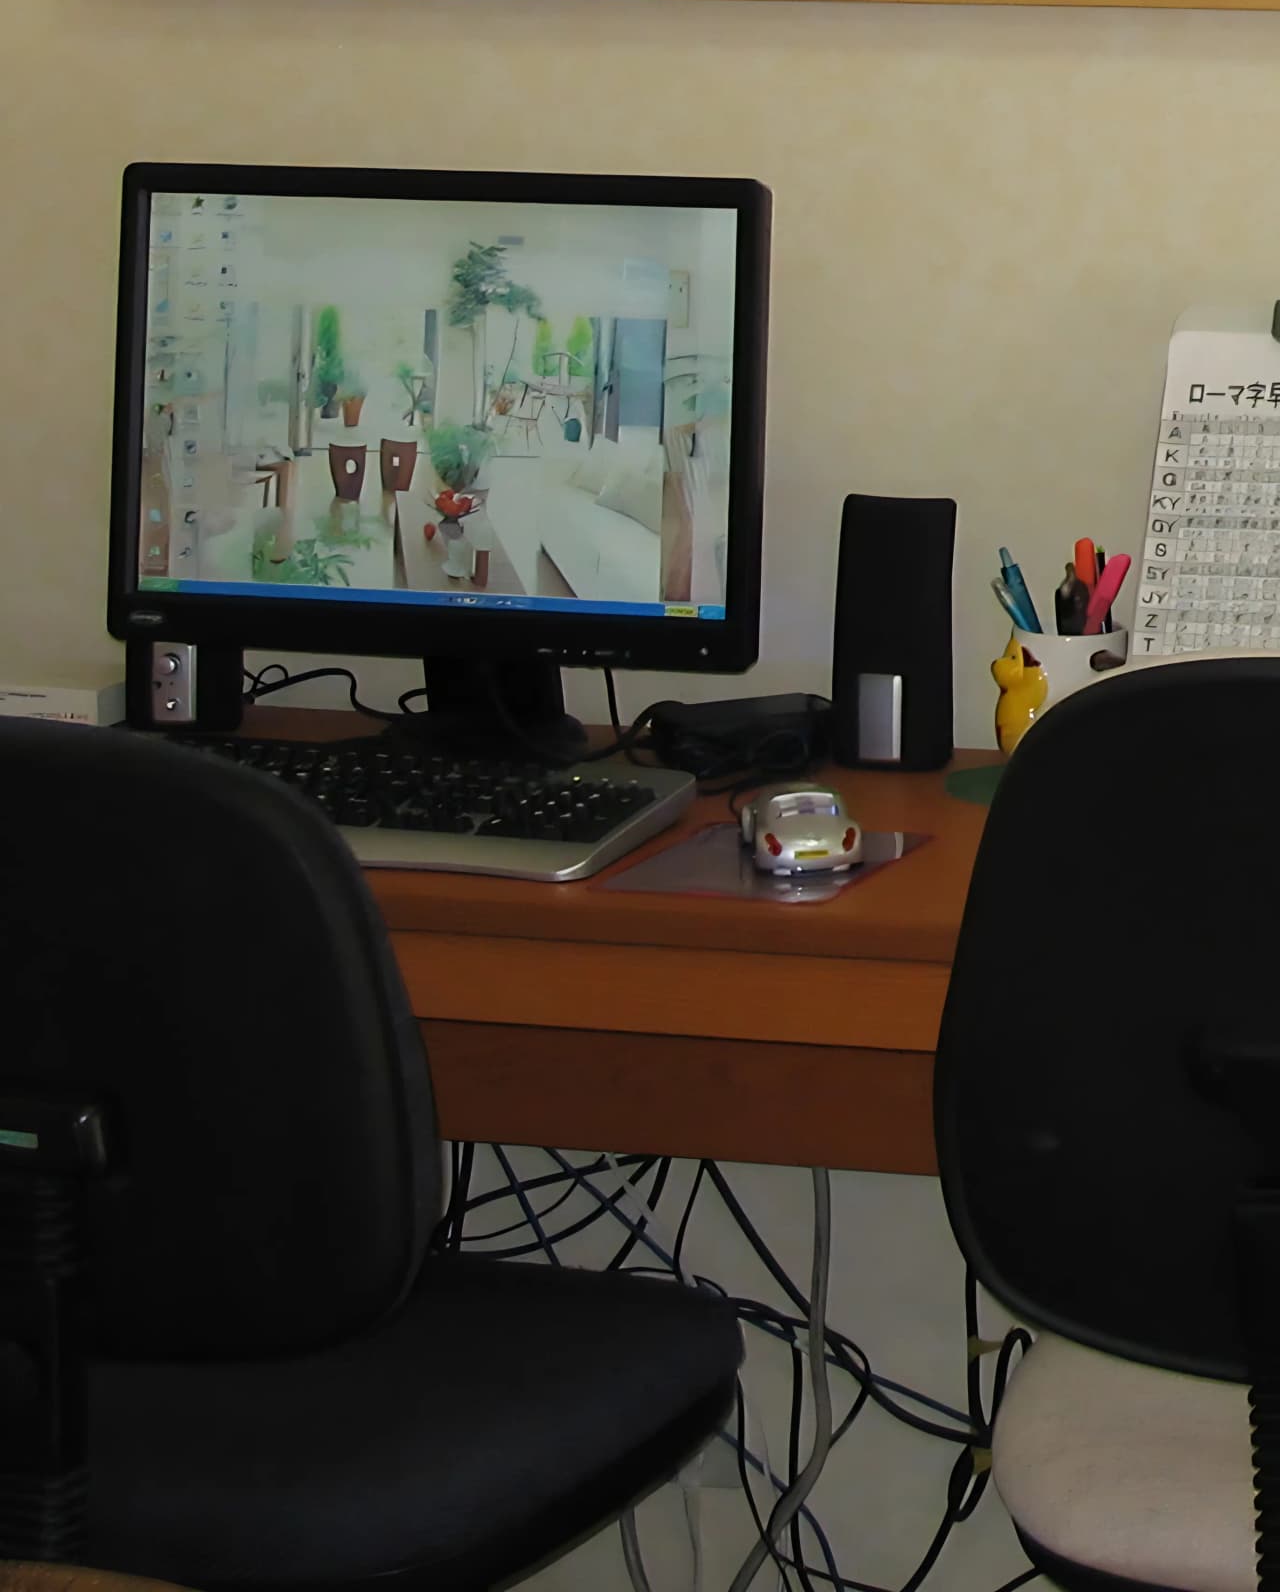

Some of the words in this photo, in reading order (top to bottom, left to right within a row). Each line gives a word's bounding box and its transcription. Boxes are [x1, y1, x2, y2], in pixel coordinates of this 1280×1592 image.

[1165, 450, 1179, 463] K
[1152, 495, 1181, 511] KY
[1142, 591, 1168, 604] JY
[1144, 614, 1159, 628] Z
[1143, 637, 1155, 652] T
